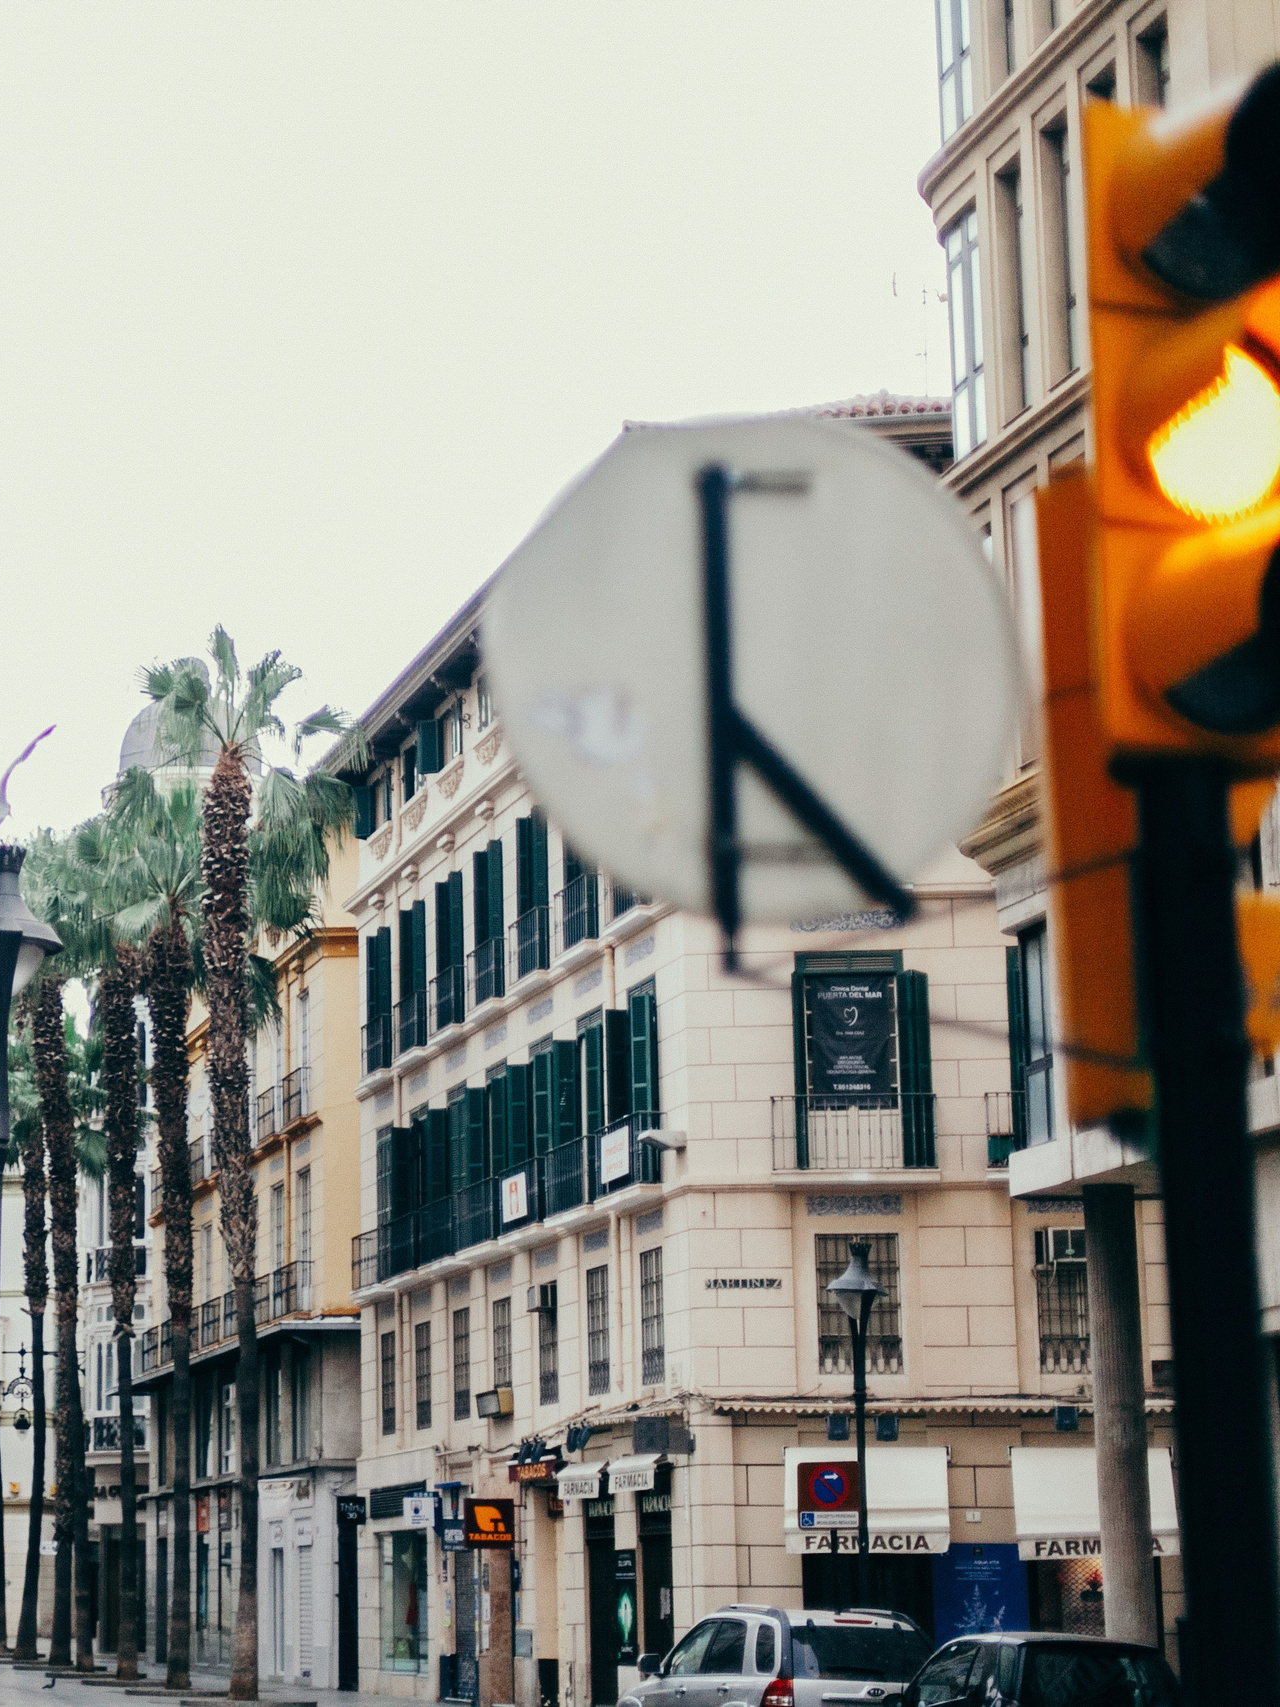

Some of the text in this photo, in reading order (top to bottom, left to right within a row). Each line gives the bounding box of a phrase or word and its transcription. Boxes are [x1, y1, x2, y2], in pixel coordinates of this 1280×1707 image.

[817, 992, 848, 1000] PUERTA
[865, 991, 883, 999] MAR
[705, 1278, 783, 1290] MARTINEZ
[516, 1463, 547, 1481] TABACOS
[614, 1472, 649, 1491] FARMACIA
[563, 1481, 595, 1499] FARMACIA
[340, 1502, 365, 1513] Thirty
[346, 1511, 358, 1520] 30
[468, 1533, 512, 1541] TABACOS
